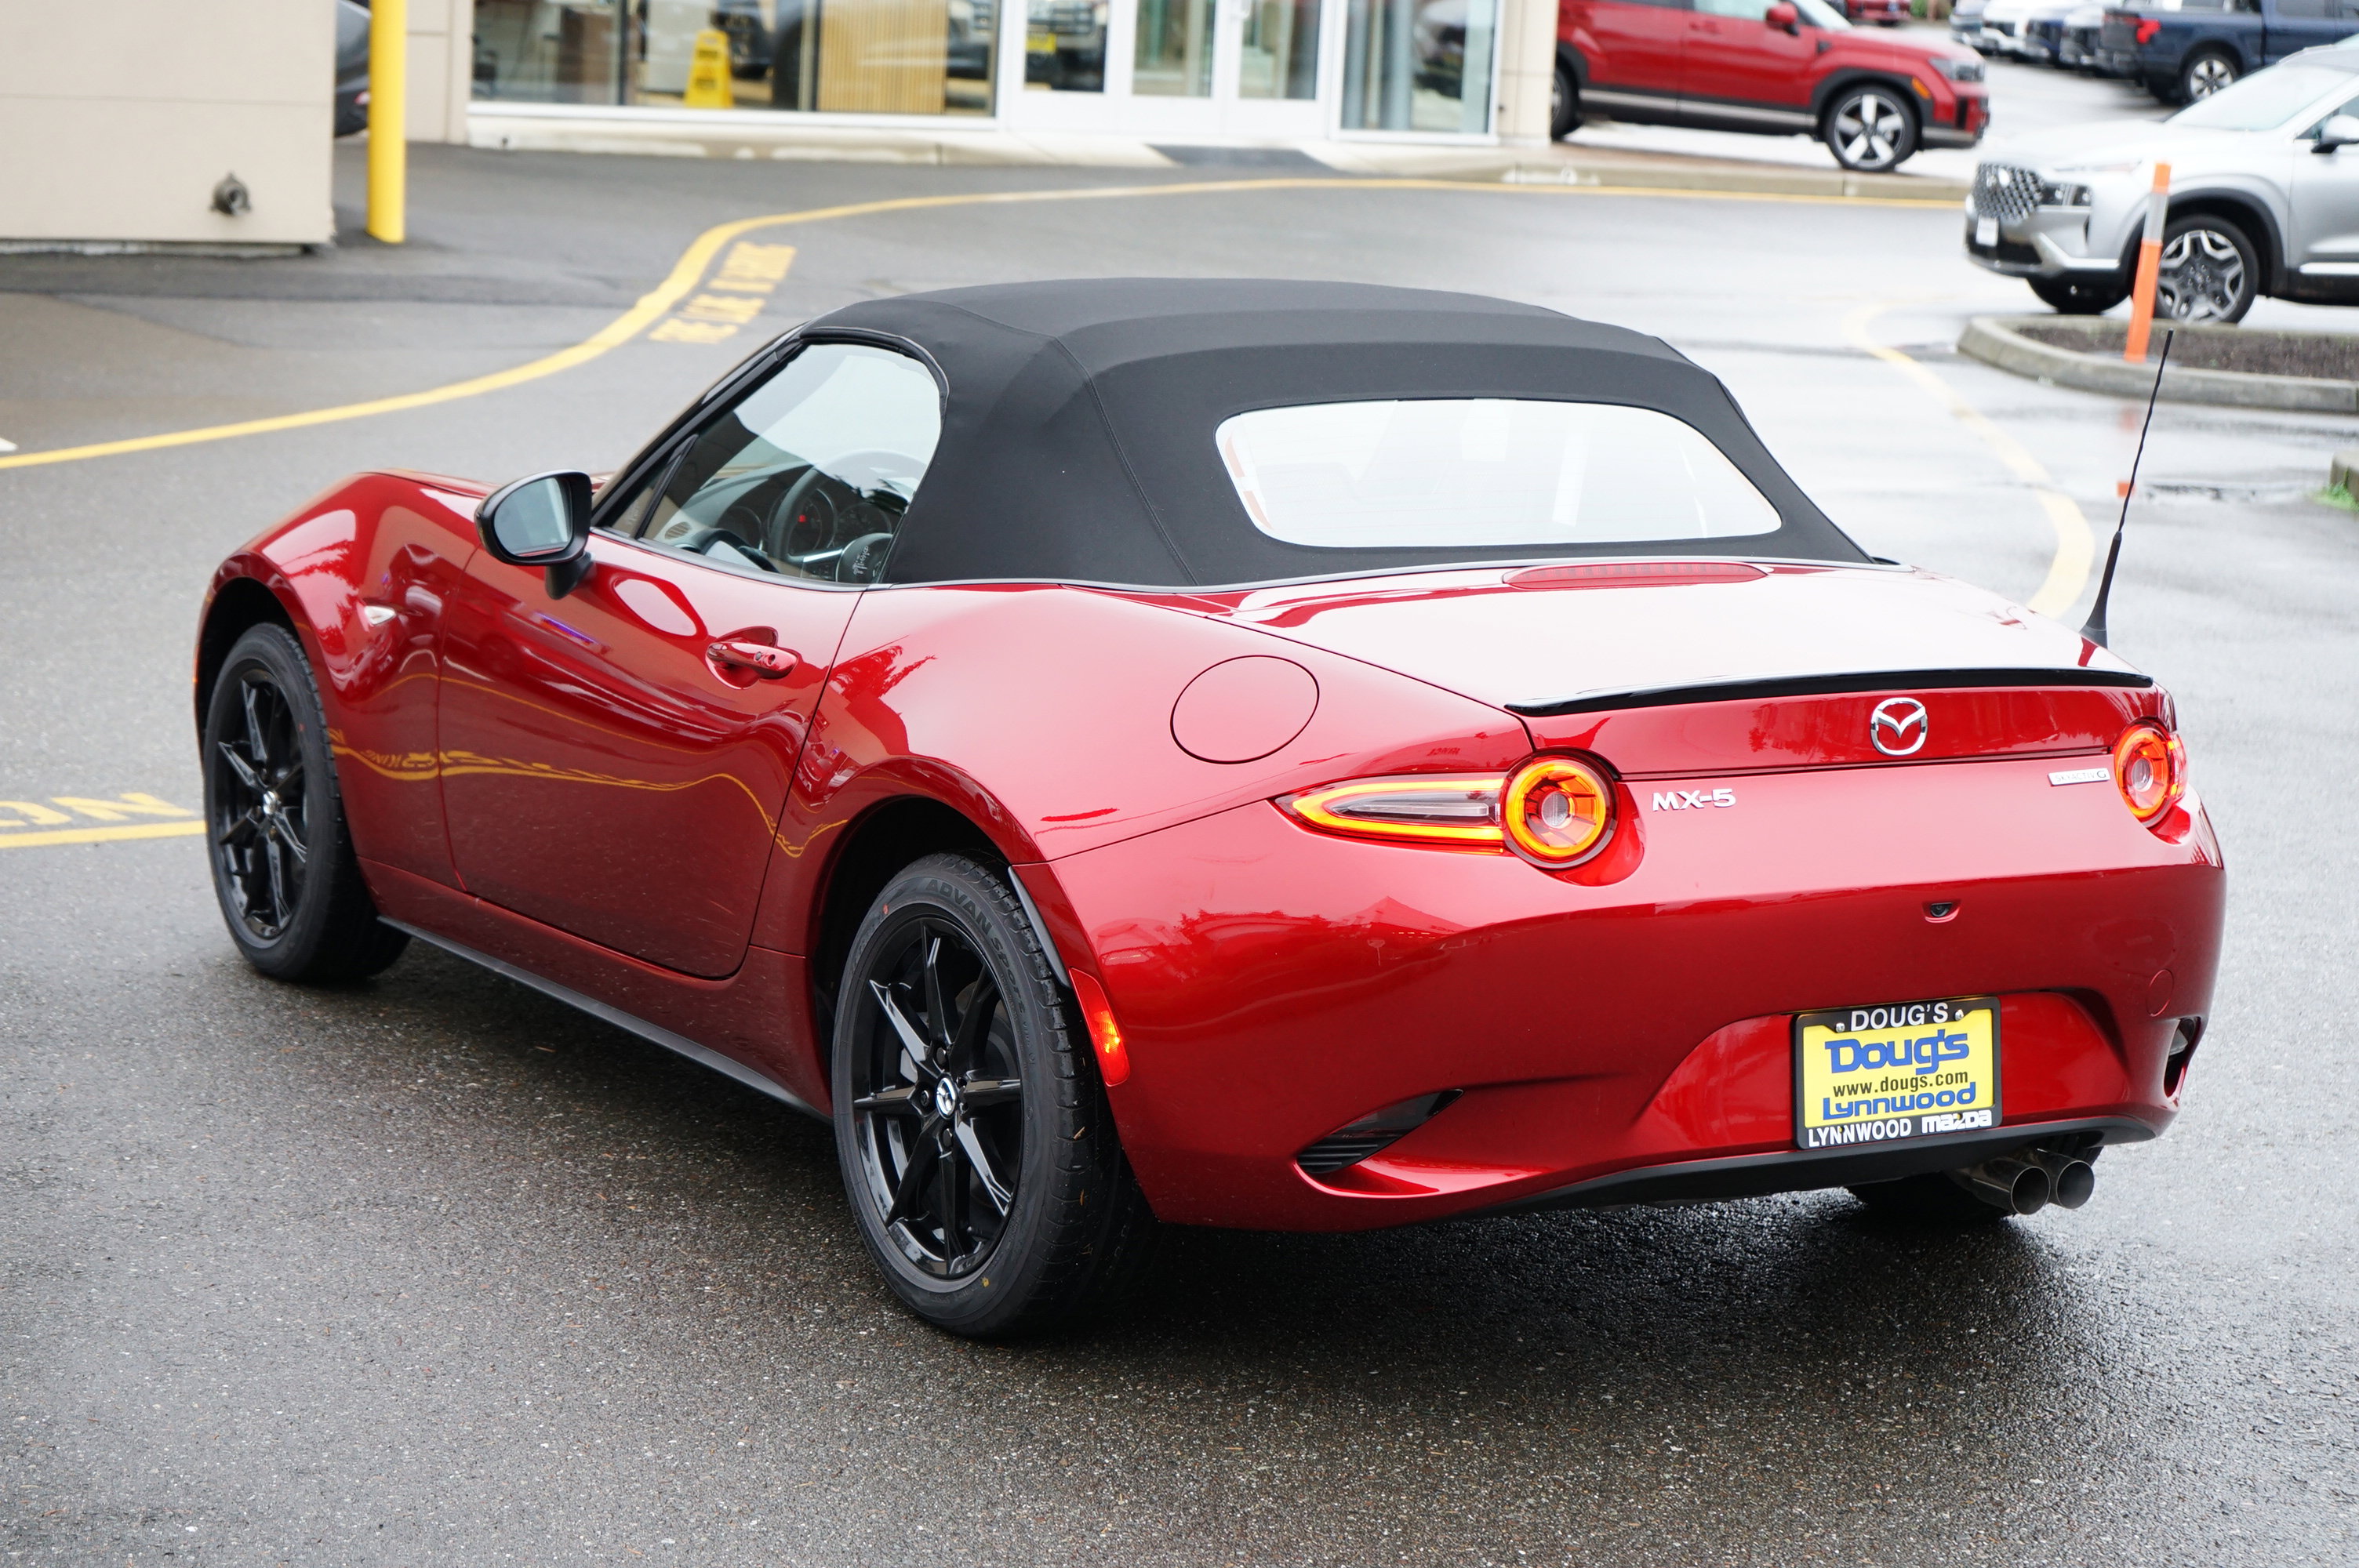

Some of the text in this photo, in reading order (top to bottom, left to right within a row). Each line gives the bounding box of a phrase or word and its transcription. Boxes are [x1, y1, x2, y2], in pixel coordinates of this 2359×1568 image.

[1652, 788, 1736, 811] MX-5
[925, 879, 993, 935] ADVAN
[1850, 1002, 1948, 1032] DOUG'S
[1824, 1029, 1969, 1075] Doug's
[1833, 1071, 1968, 1097] www.dougs.com
[1823, 1081, 1976, 1120] Lynnwood
[1808, 1117, 1912, 1148] LYNNWOOD
